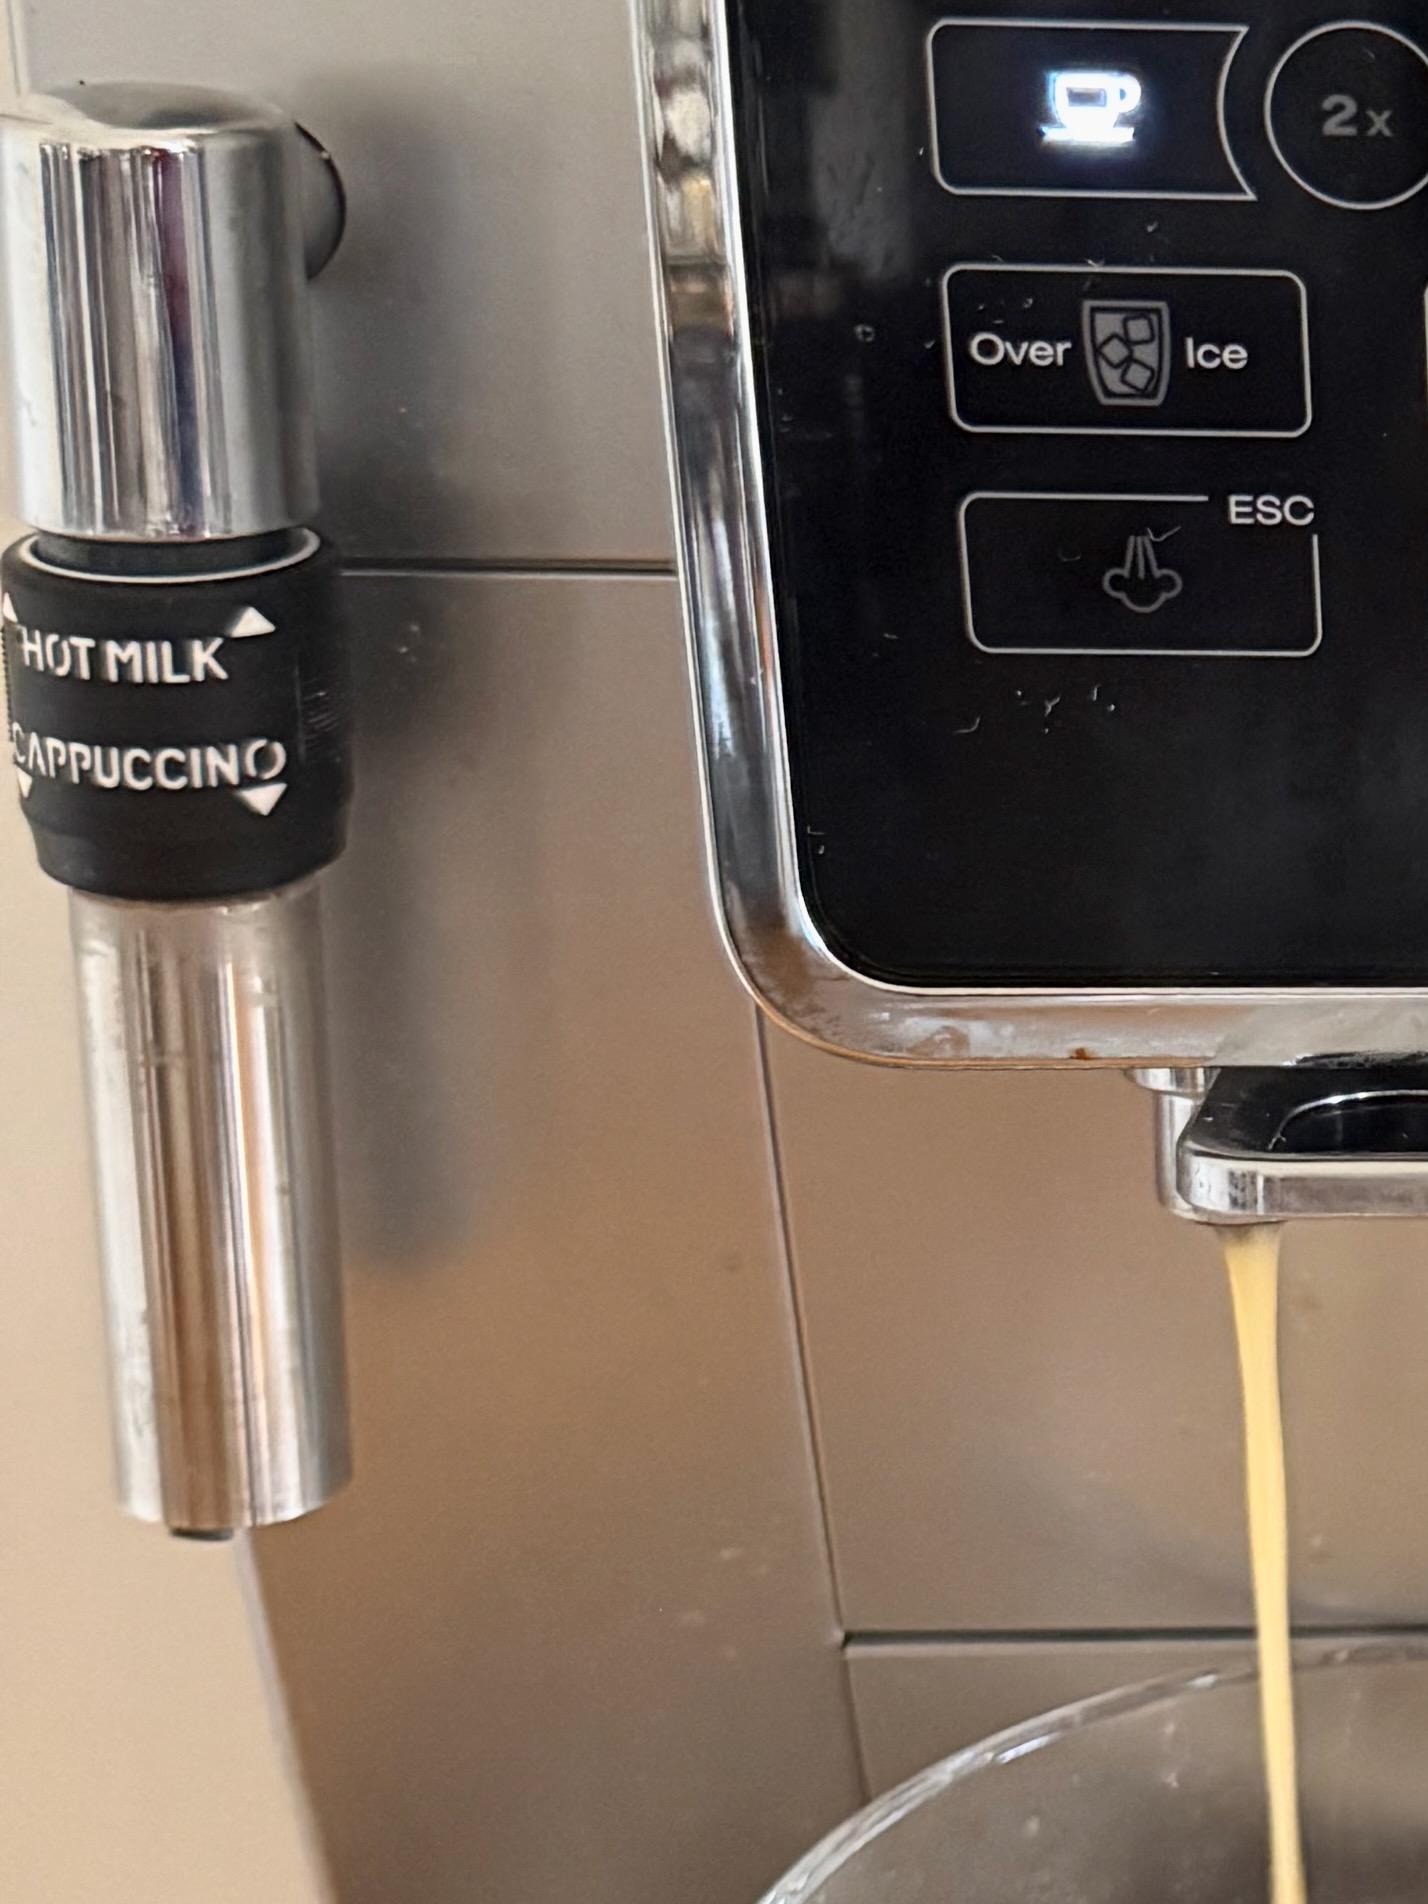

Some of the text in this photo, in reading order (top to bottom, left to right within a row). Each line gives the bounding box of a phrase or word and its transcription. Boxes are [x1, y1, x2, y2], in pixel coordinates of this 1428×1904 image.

[968, 333, 1249, 370] Over Ice
[1228, 495, 1315, 527] ESC
[20, 627, 229, 684] HOT MILK
[10, 722, 287, 790] CAPPUCCINO
